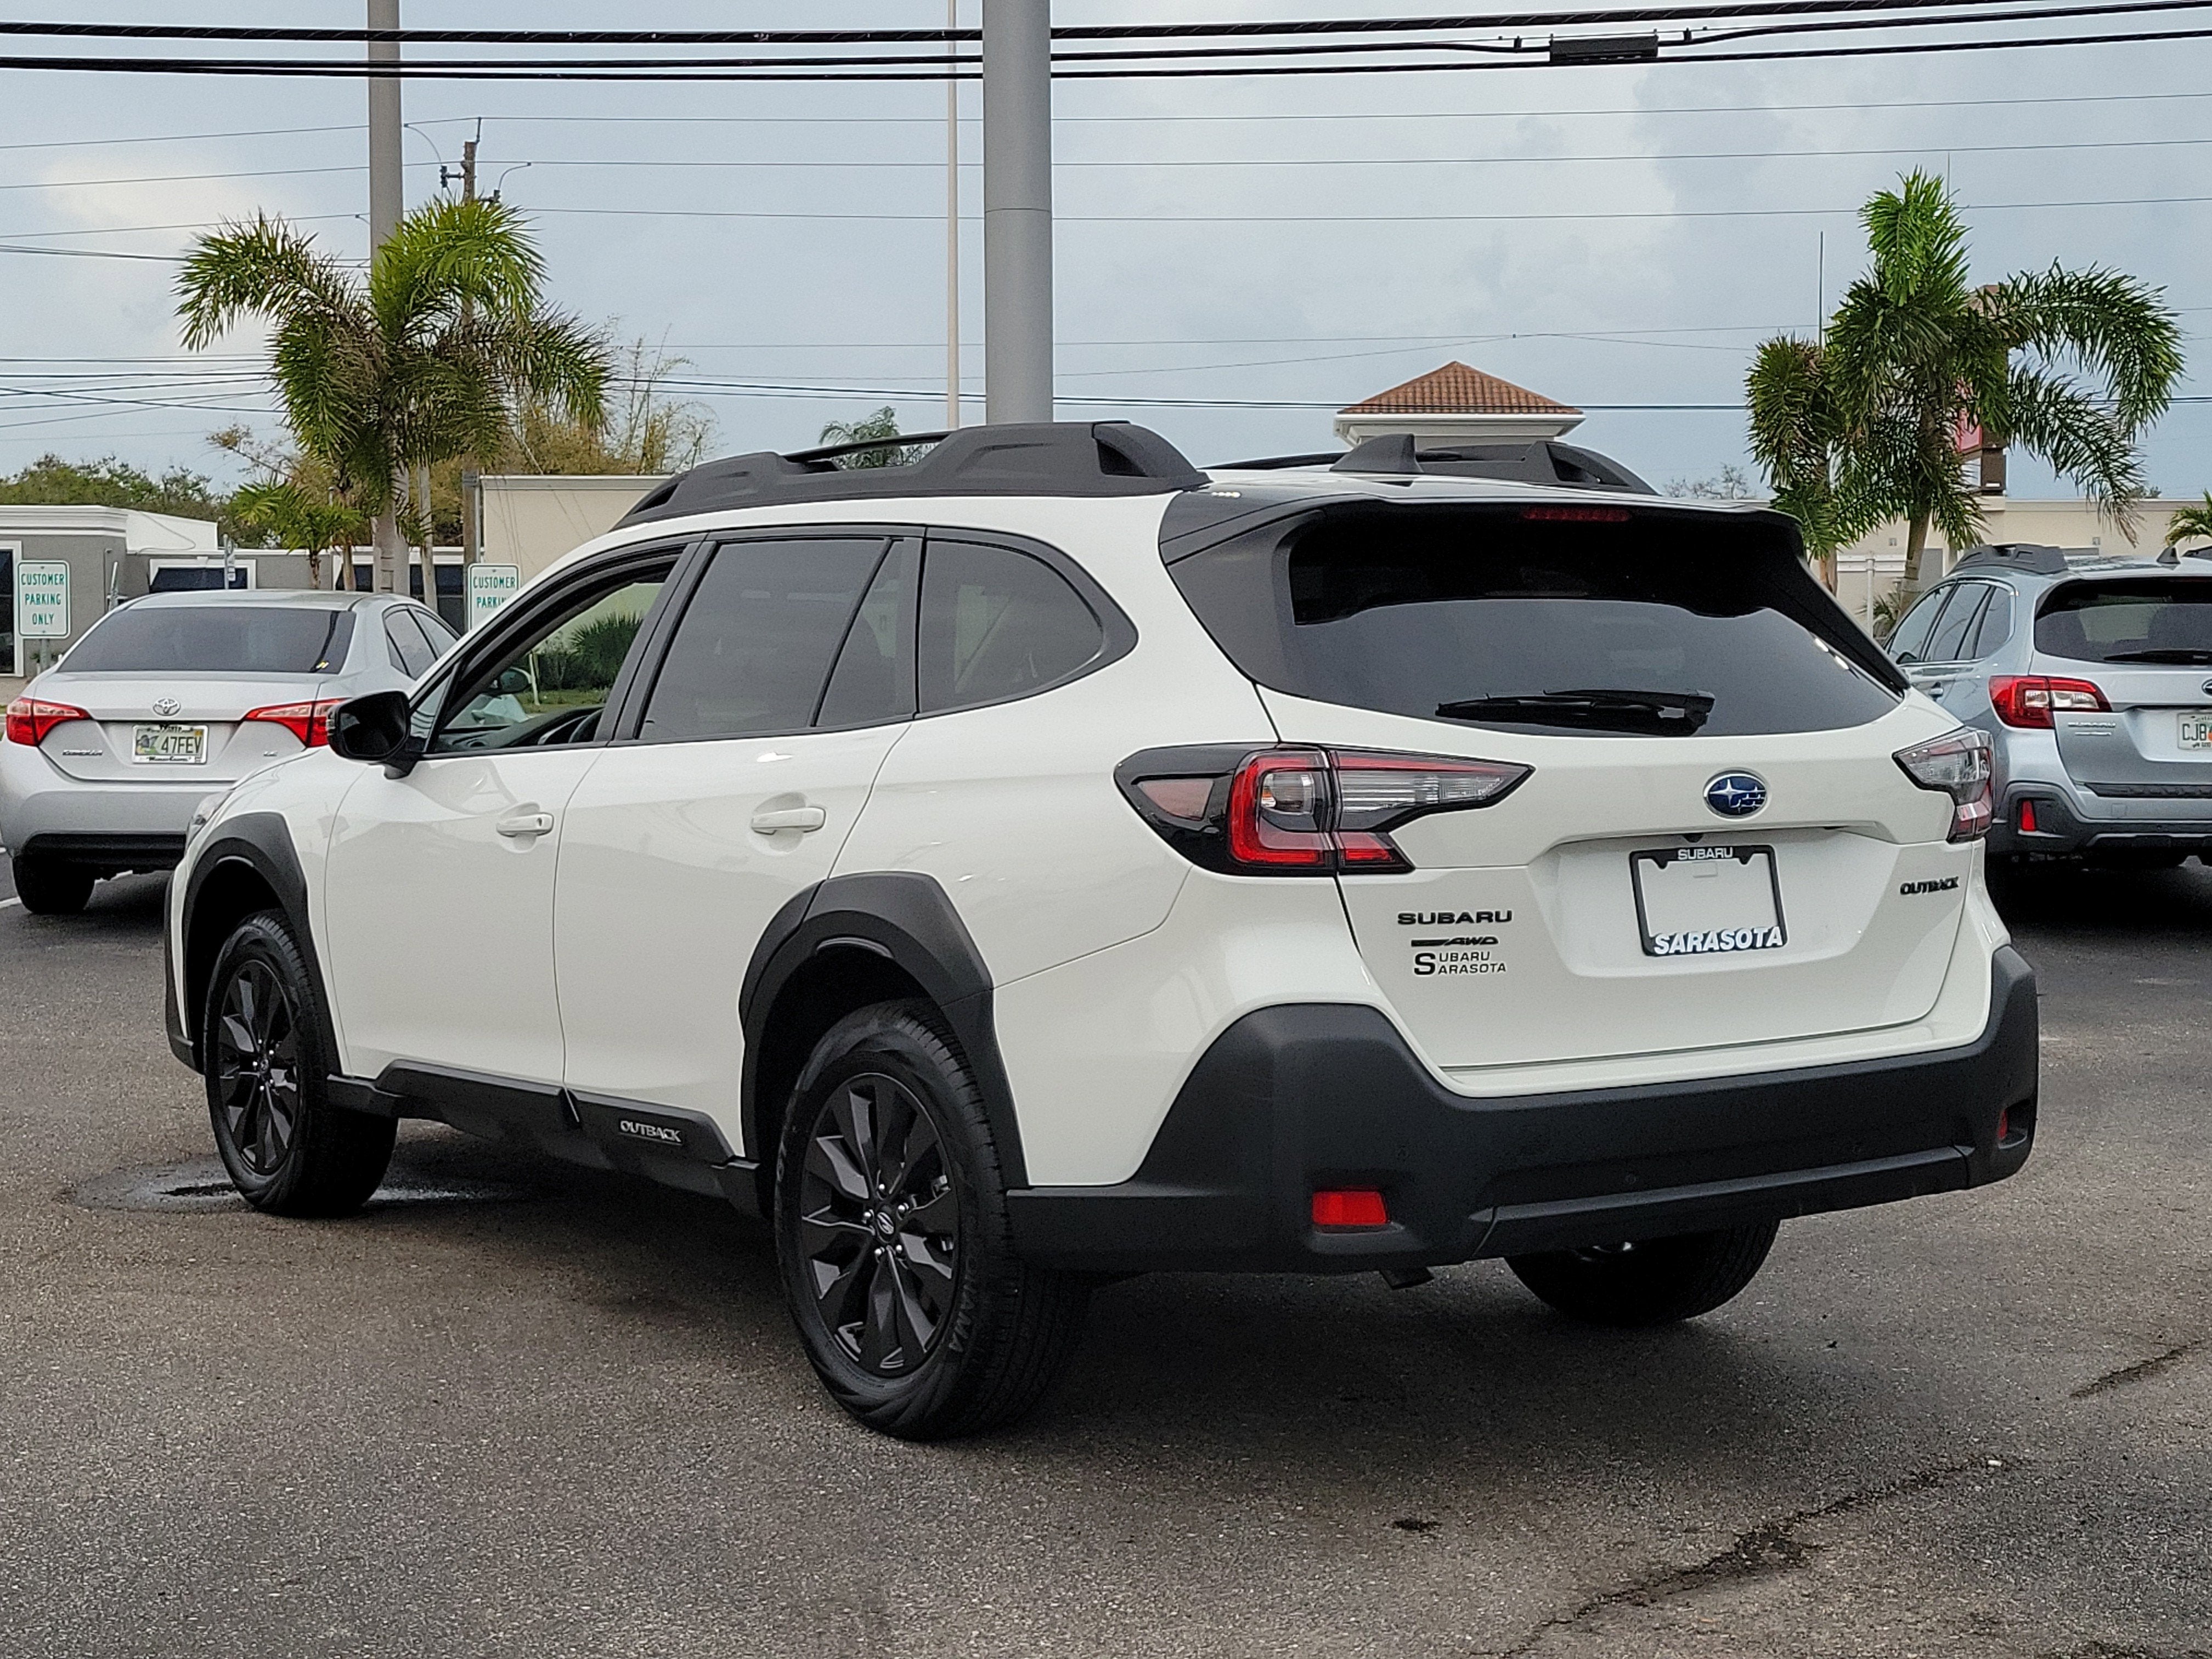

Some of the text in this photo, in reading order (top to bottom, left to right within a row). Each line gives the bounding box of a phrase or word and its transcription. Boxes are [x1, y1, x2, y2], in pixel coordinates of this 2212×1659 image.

[21, 573, 65, 585] CUSTOMER
[473, 576, 515, 589] CUSTOMER
[25, 594, 61, 605] PARKING
[477, 596, 506, 608] PARKI
[32, 613, 54, 625] ONLY
[161, 736, 202, 753] 47FEV
[1677, 848, 1733, 860] SUBARU
[1900, 876, 1959, 895] OUTBACK
[1398, 910, 1512, 925] SUBARU
[1444, 936, 1499, 946] AWD
[1654, 926, 1782, 955] SARASOTA
[620, 1120, 681, 1142] OUTBACK
